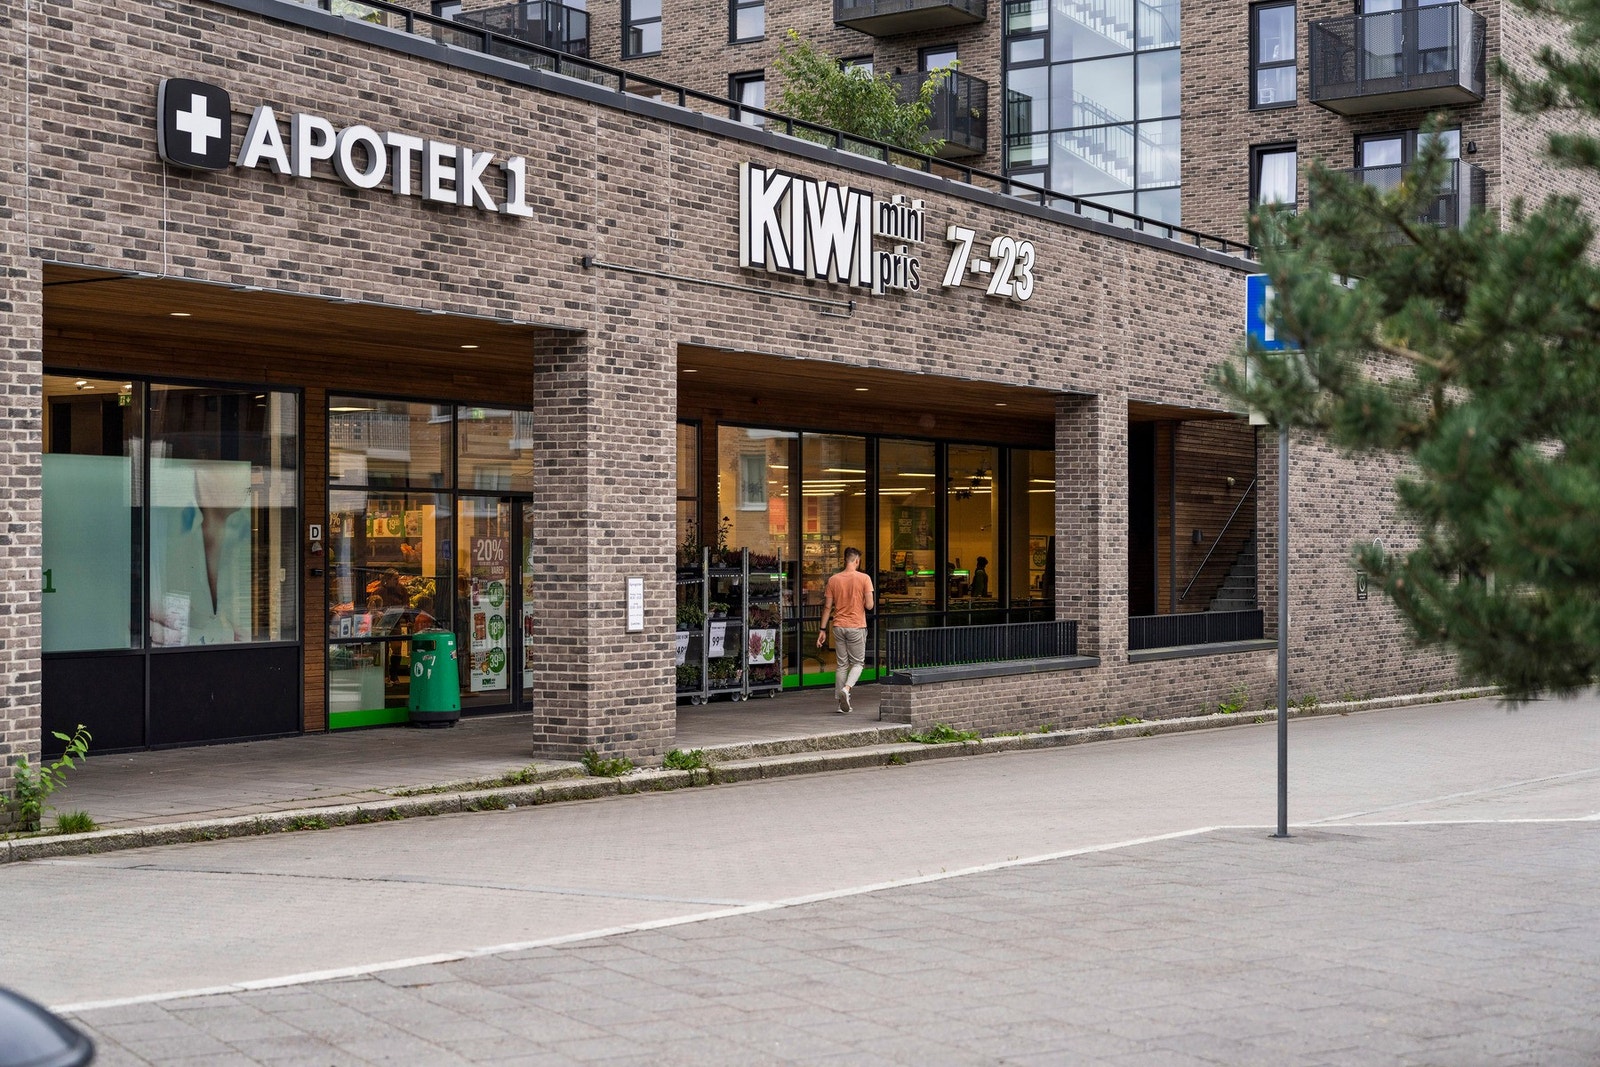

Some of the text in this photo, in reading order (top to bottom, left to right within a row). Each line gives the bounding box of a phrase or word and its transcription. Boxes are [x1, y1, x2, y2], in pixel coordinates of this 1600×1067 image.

[236, 105, 534, 218] APOTEK 1
[740, 162, 874, 289] KIWI
[874, 194, 925, 244] mini
[872, 245, 920, 296] pris
[942, 225, 1036, 302] 7-23
[312, 527, 319, 538] D
[473, 539, 504, 561] -20%
[42, 568, 57, 593] 1
